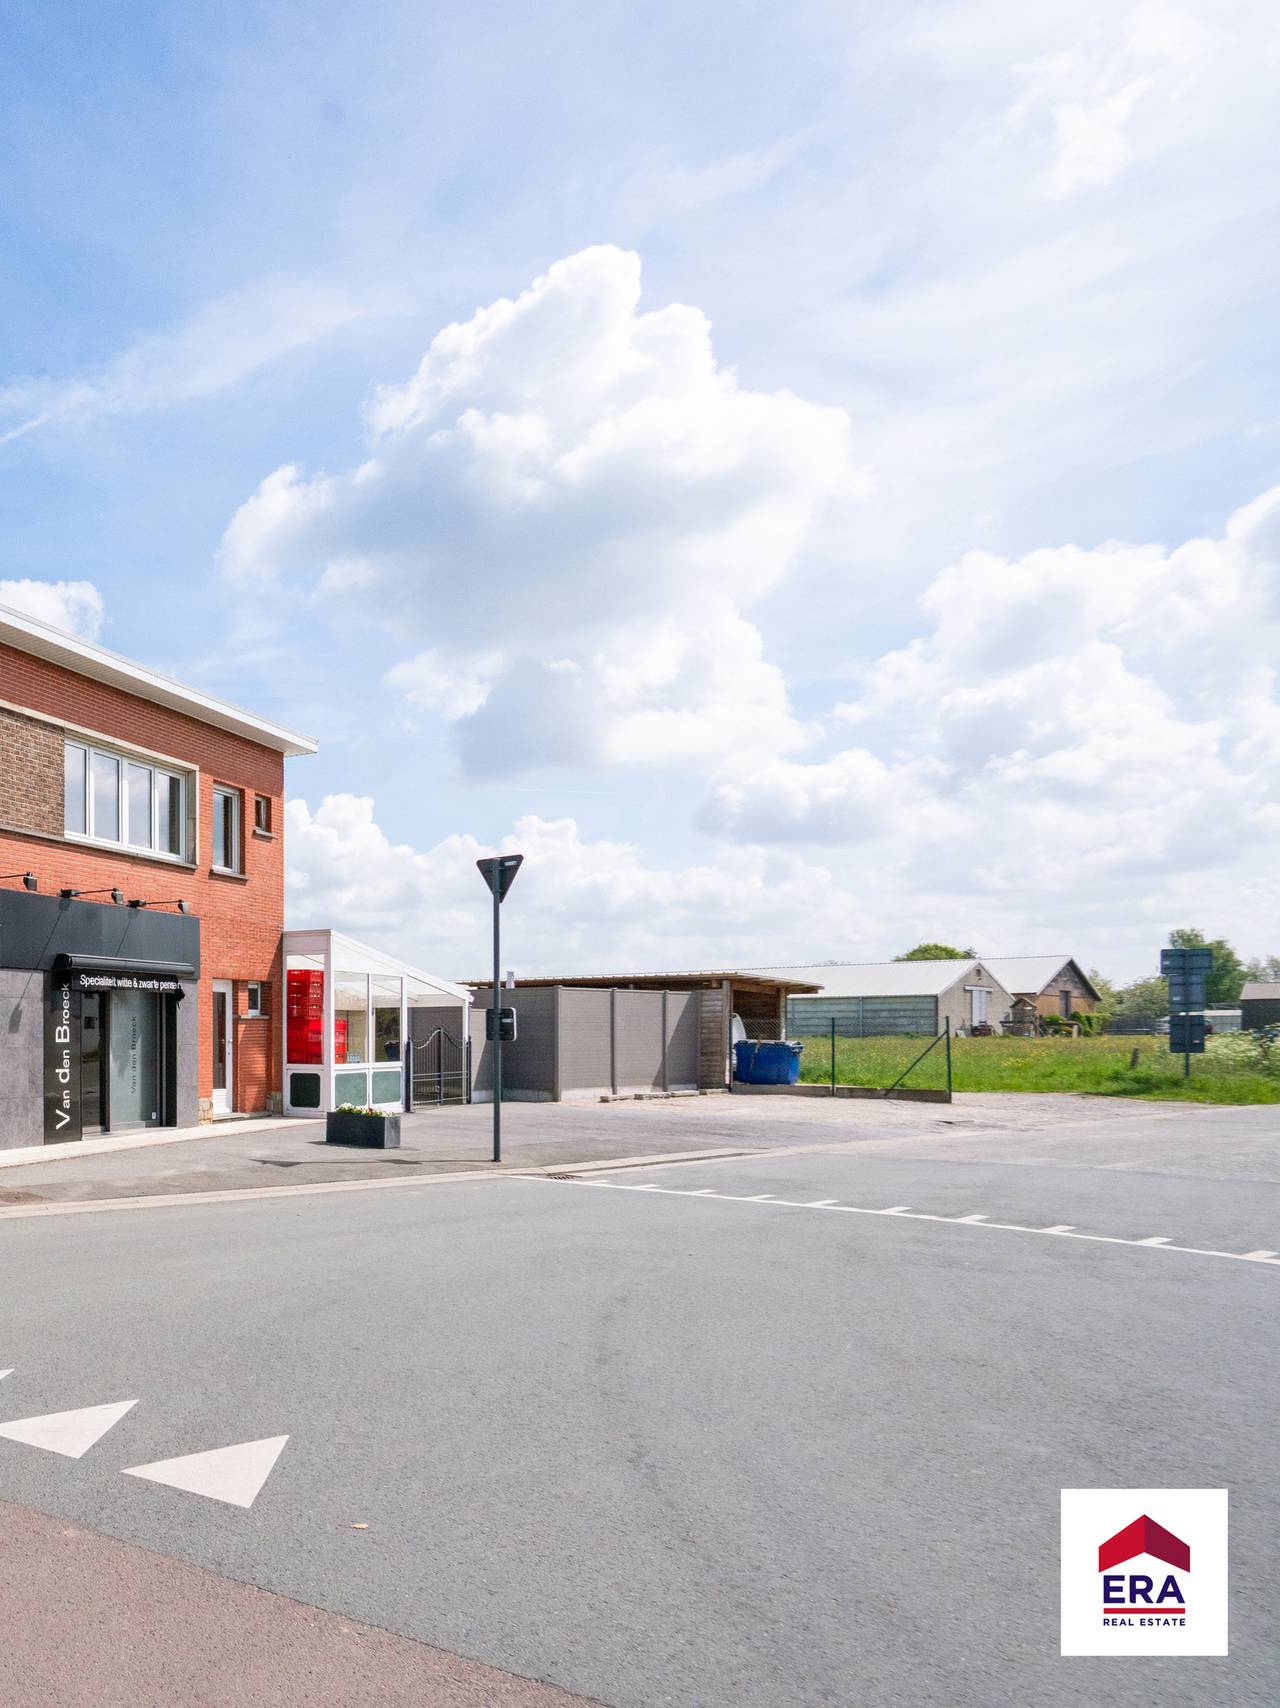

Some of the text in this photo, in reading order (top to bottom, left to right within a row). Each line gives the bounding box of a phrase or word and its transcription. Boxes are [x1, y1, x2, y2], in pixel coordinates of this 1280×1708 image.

[80, 974, 116, 988] Specialiteit
[117, 976, 132, 988] witte
[133, 978, 139, 989] &
[139, 979, 159, 990] zwarte
[55, 983, 70, 1130] Van den Broeck
